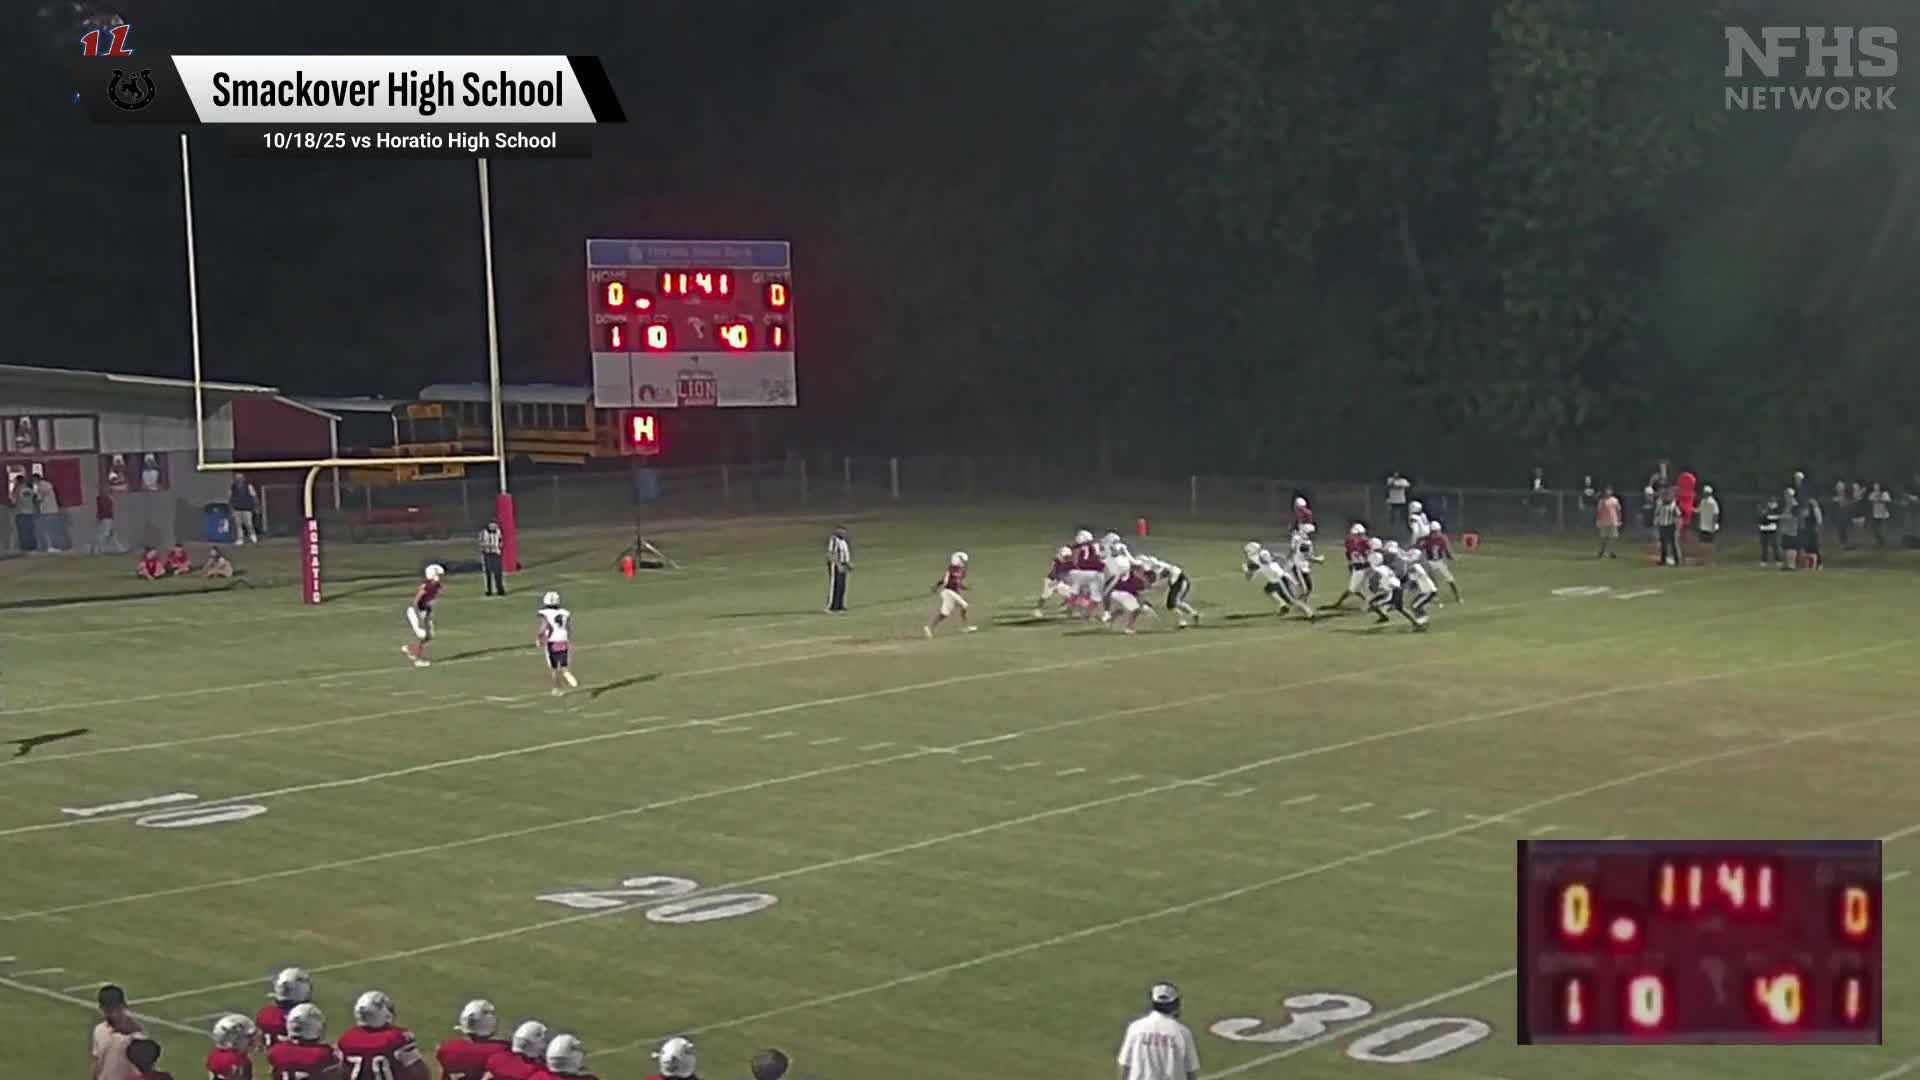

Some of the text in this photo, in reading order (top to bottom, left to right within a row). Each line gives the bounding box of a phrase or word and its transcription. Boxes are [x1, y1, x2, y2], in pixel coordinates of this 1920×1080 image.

[607, 282, 624, 306] 0
[770, 283, 785, 306] 0
[612, 326, 621, 348] 1
[647, 324, 668, 349] 0
[720, 324, 749, 349] 40
[774, 326, 782, 347] 1
[633, 416, 655, 442] H
[534, 875, 779, 924] 20
[1210, 993, 1491, 1063] 30
